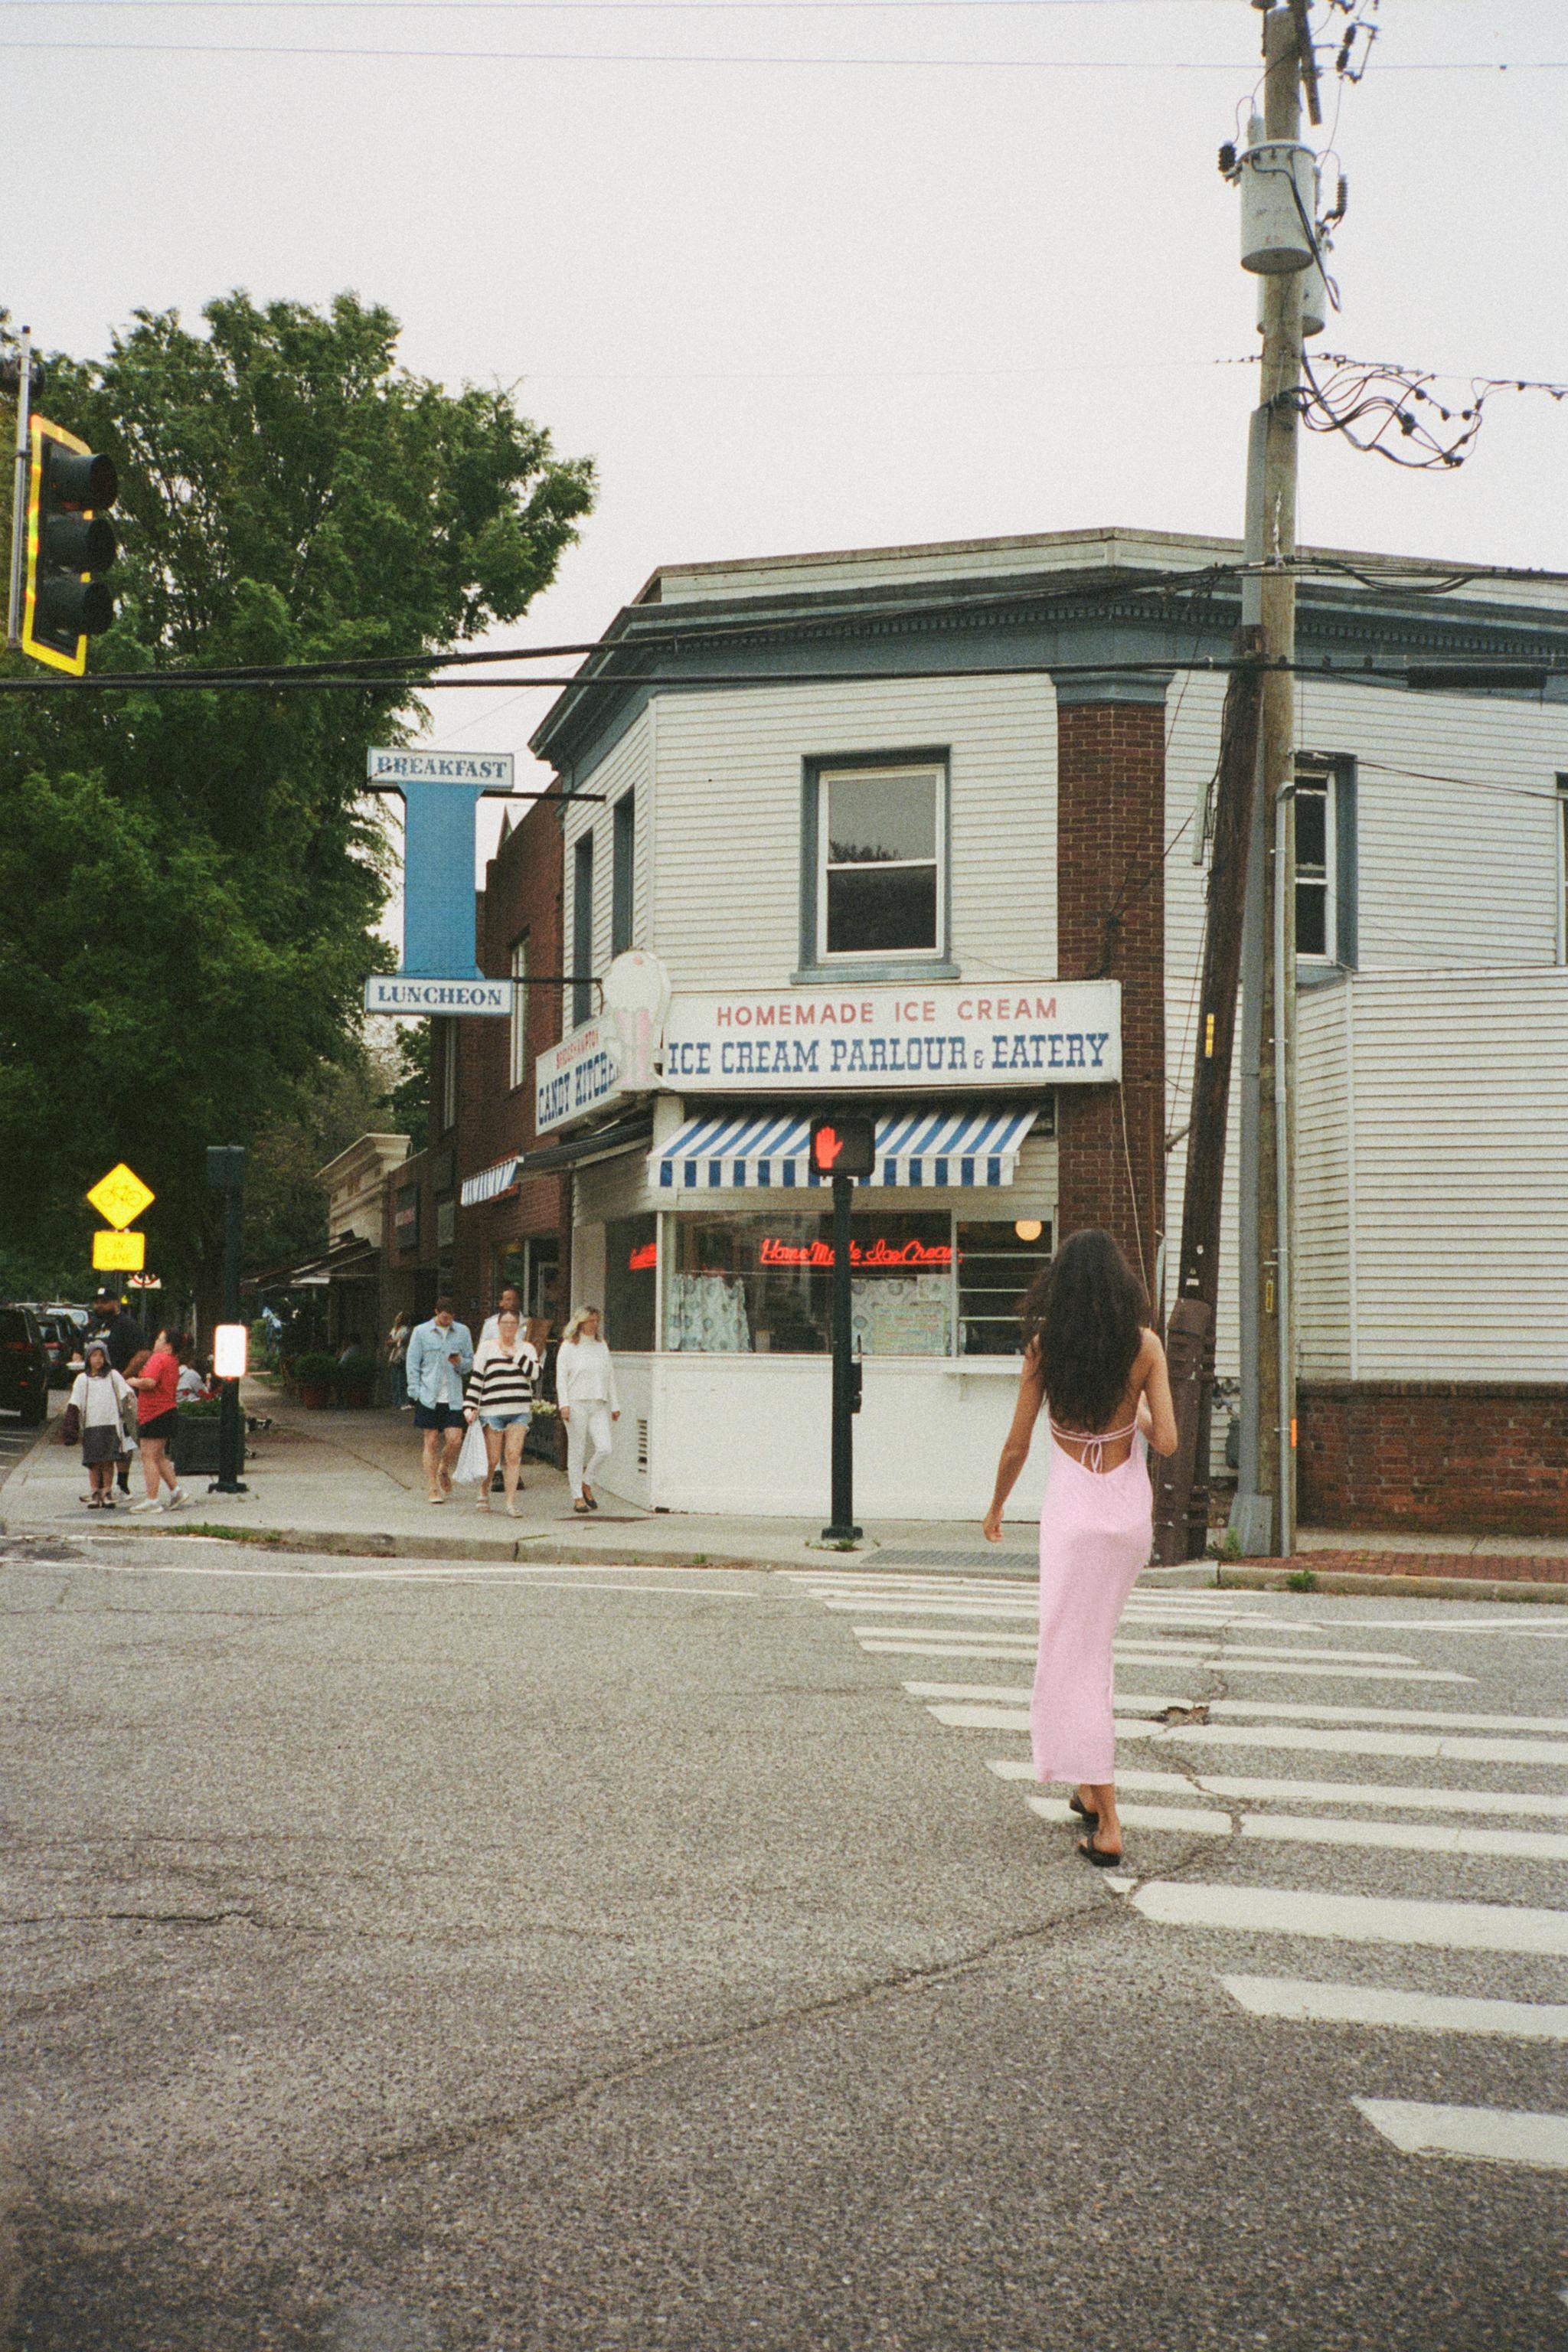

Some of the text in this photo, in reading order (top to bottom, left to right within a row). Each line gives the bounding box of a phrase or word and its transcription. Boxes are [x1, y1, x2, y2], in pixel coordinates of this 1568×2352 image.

[375, 755, 508, 779] BREAKFAST
[377, 985, 502, 1006] LUNCHEON
[717, 998, 1057, 1027] HOMEMADE ICE CREAM
[668, 1032, 1110, 1076] ICE CREAM PARLOUR & EATERY
[538, 1071, 570, 1126] CANDY
[113, 1240, 124, 1250] IN
[760, 1238, 809, 1262] Home
[104, 1252, 131, 1263] LANE
